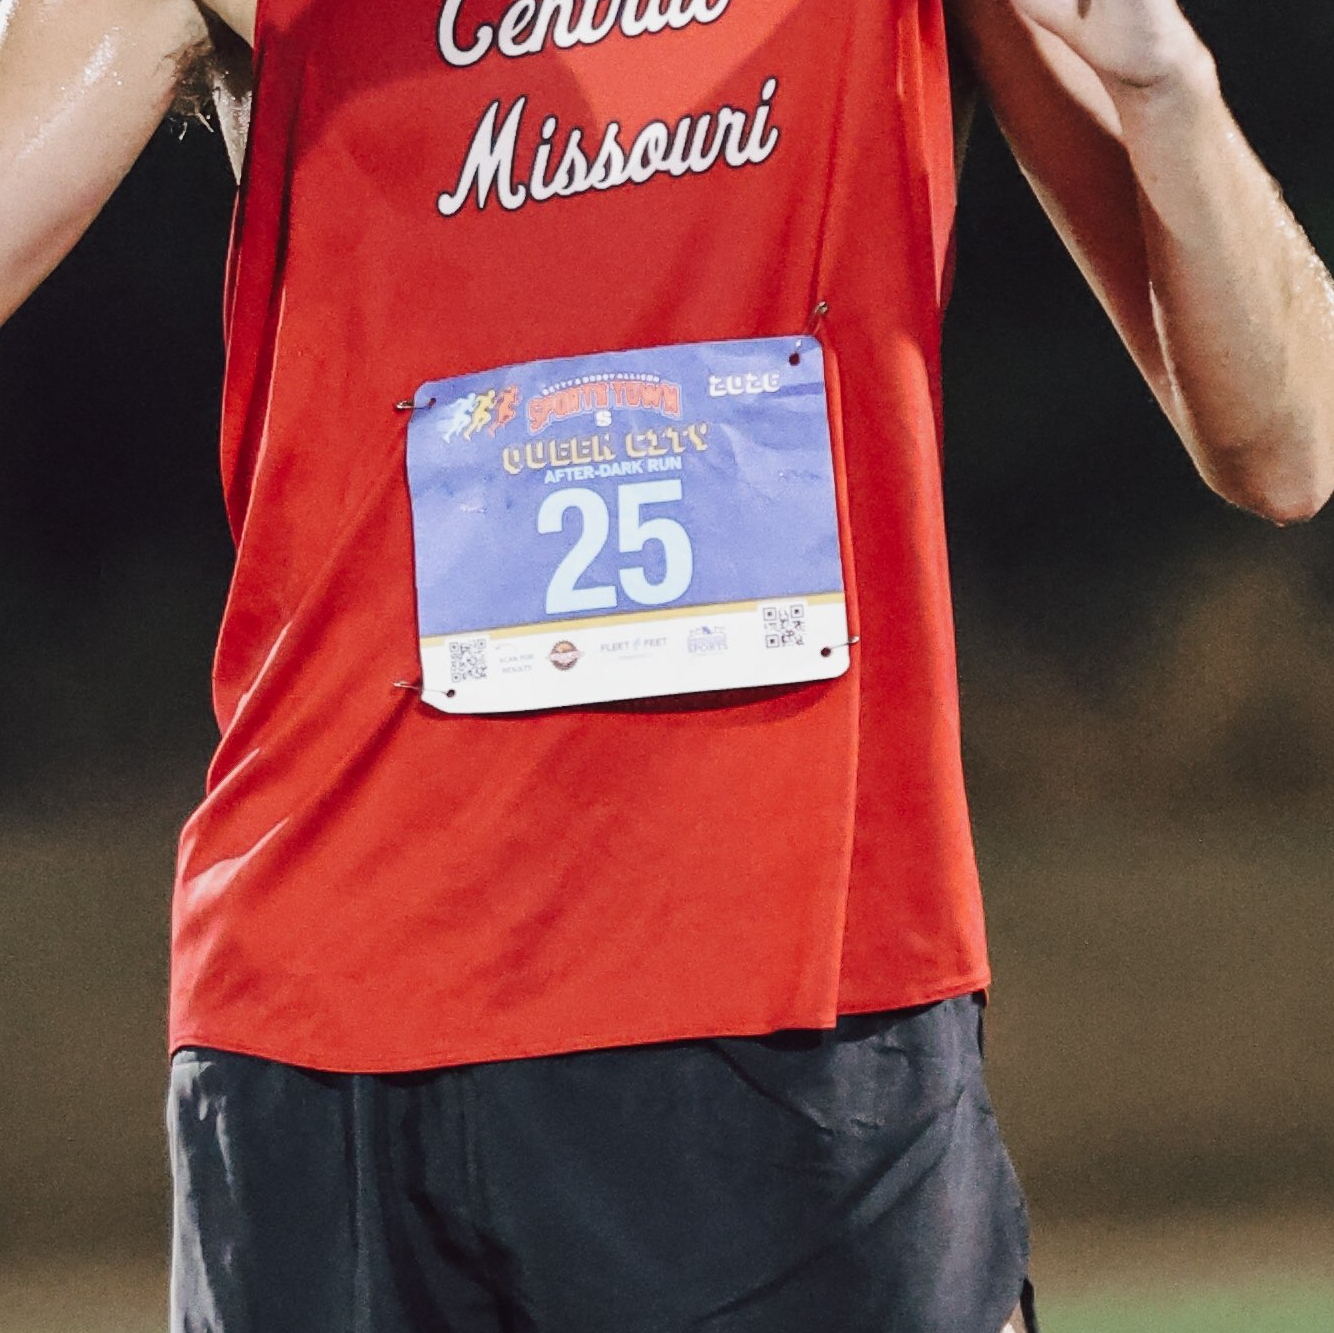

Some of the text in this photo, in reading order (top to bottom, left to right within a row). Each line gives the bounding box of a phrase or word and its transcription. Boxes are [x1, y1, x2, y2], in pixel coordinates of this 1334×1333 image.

[437, 76, 780, 217] Missouri
[611, 380, 681, 419] TOWN
[502, 422, 709, 474] QUEEN CITY
[544, 456, 683, 485] AFTER-DARK RUN
[536, 479, 694, 615] 25
[600, 636, 667, 653] FLEET FEET
